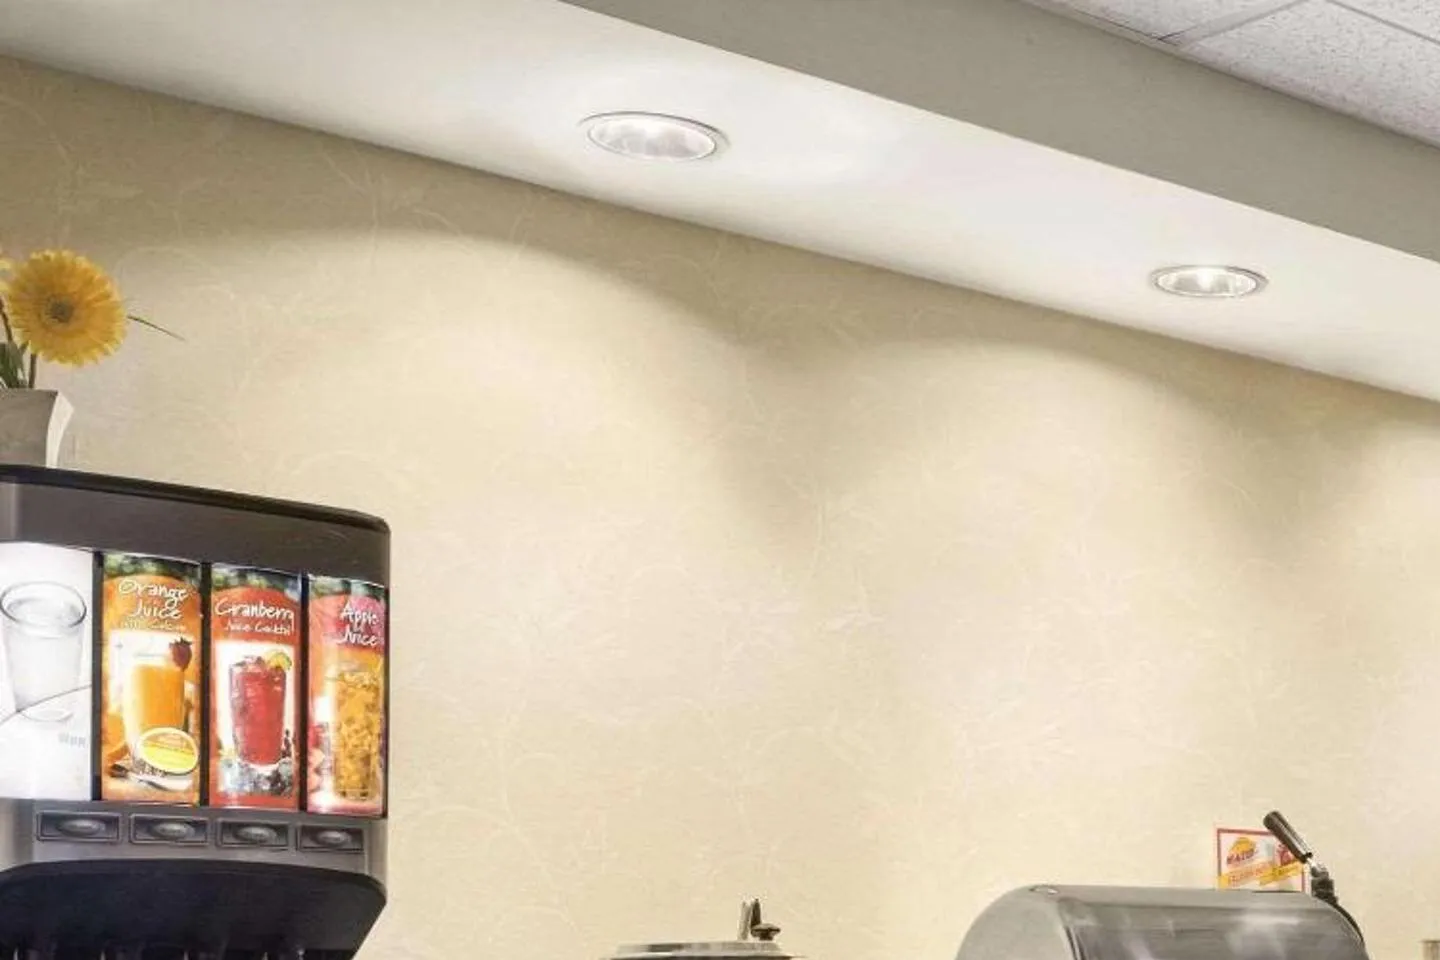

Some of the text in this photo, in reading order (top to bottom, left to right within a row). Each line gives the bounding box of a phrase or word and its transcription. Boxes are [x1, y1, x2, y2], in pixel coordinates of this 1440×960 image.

[119, 579, 188, 609] Orange
[128, 599, 182, 620] Juice
[214, 599, 294, 632] Cranberry
[340, 600, 379, 632] Apple
[334, 627, 379, 647] Juice
